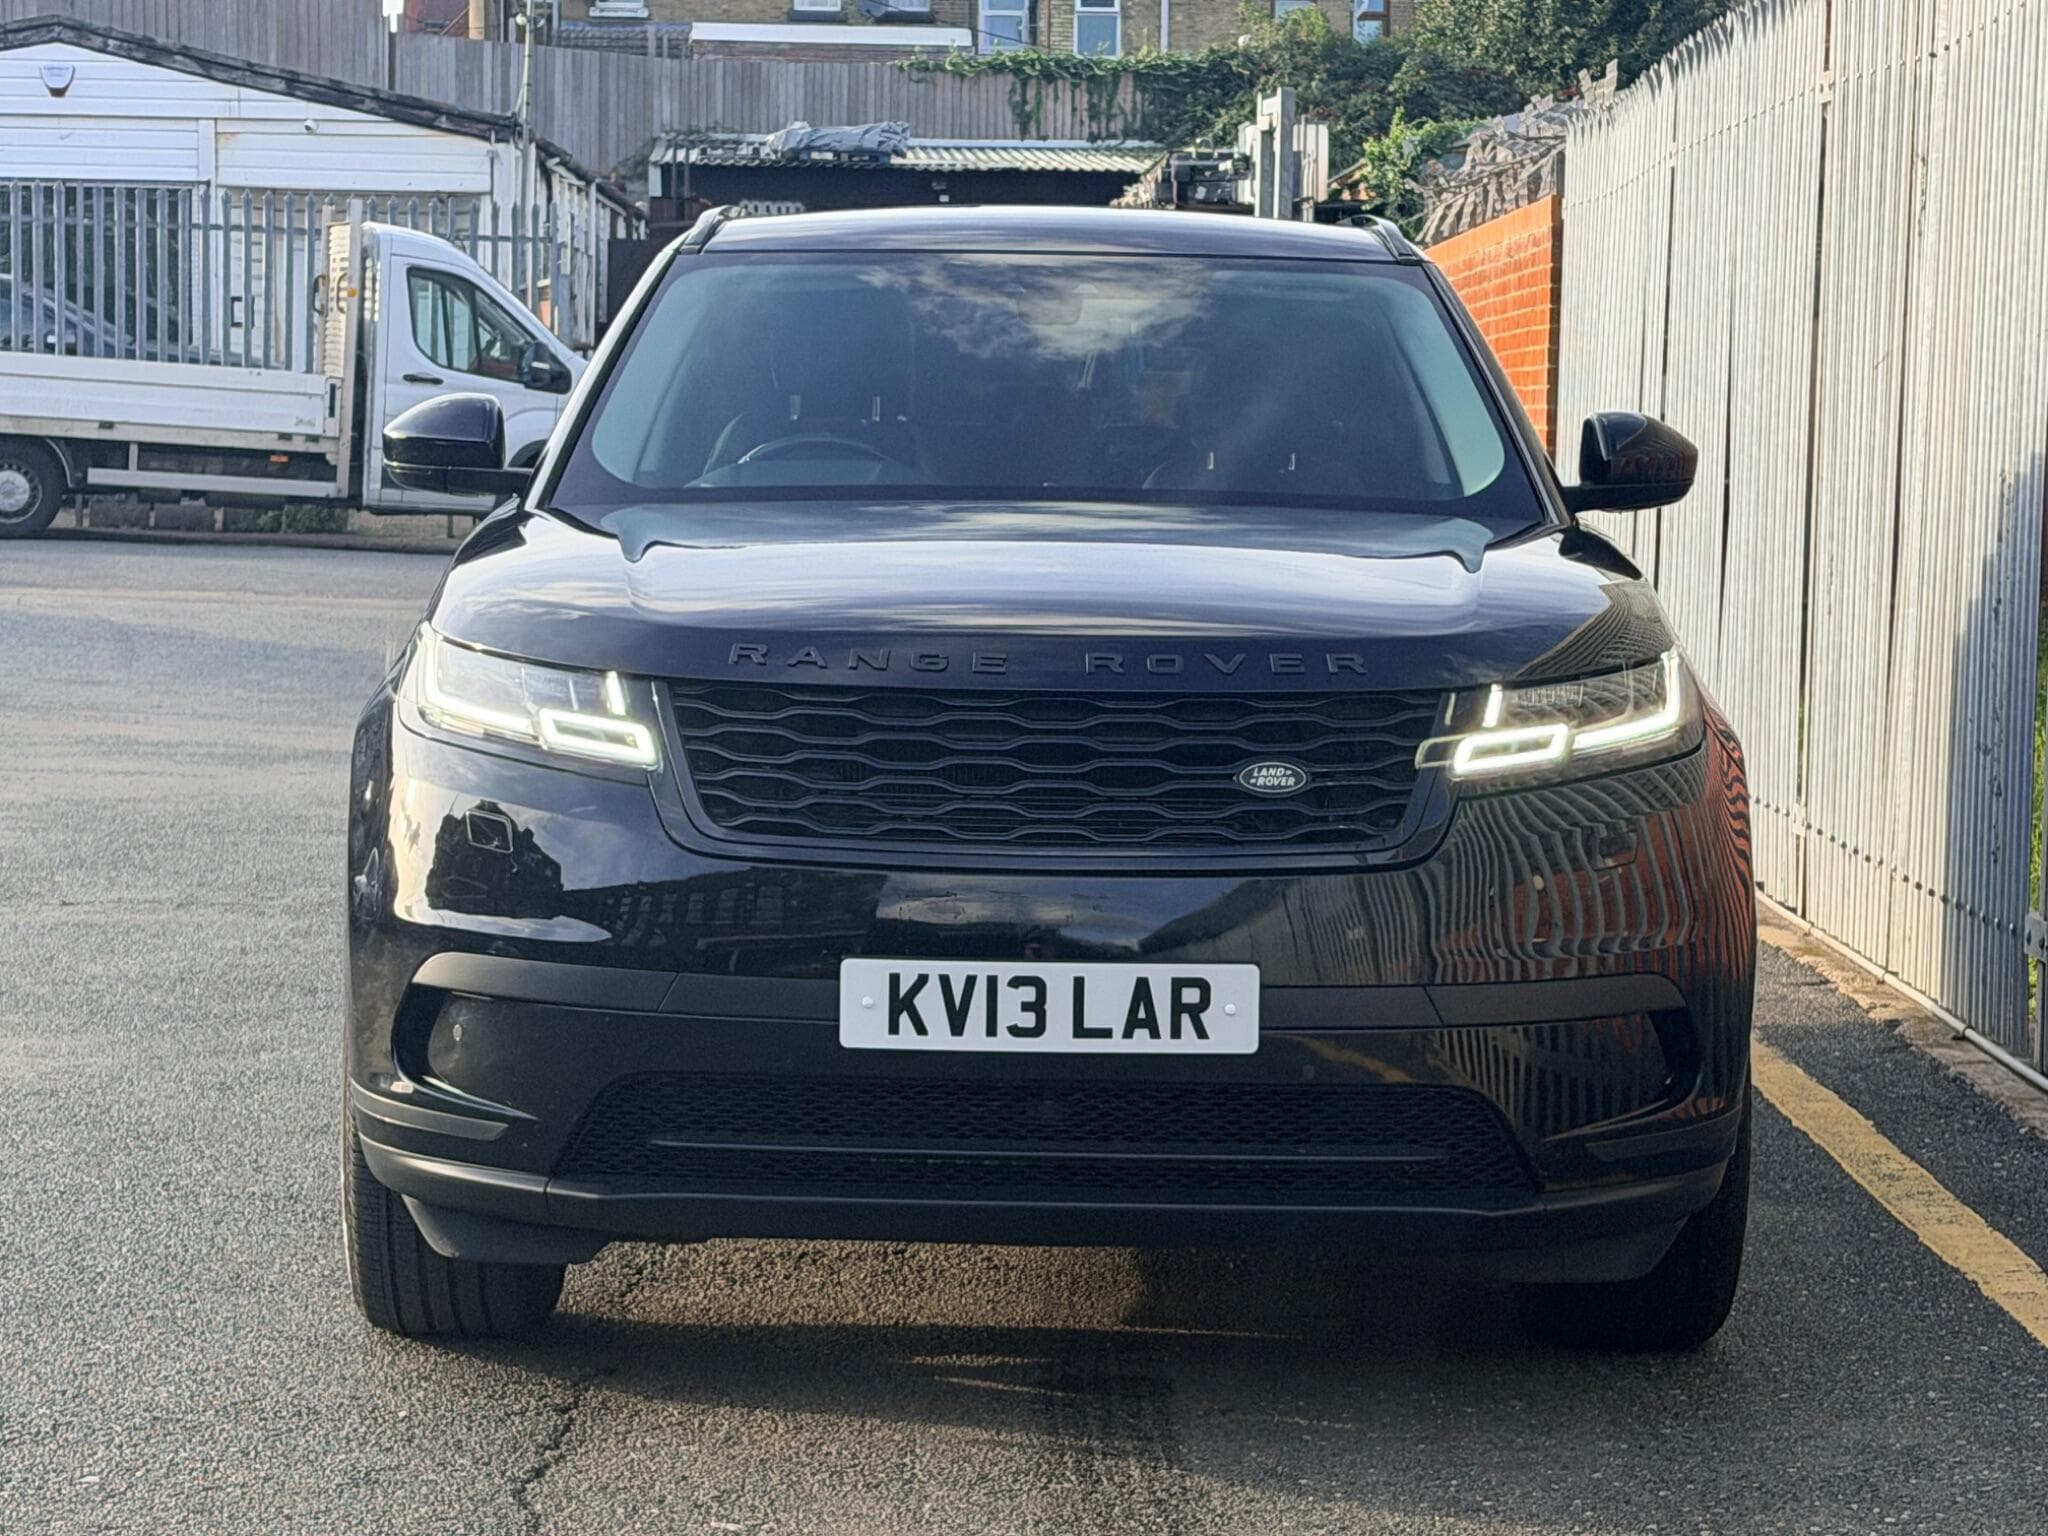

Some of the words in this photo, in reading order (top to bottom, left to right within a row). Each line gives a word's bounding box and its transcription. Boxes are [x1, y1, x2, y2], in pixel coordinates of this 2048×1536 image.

[728, 643, 1008, 674] RANGE
[1085, 652, 1369, 675] ROVER
[1253, 768, 1285, 776] LAND
[1257, 777, 1295, 786] ROVER
[888, 973, 1047, 1038] KV13
[1072, 976, 1211, 1040] LAR
